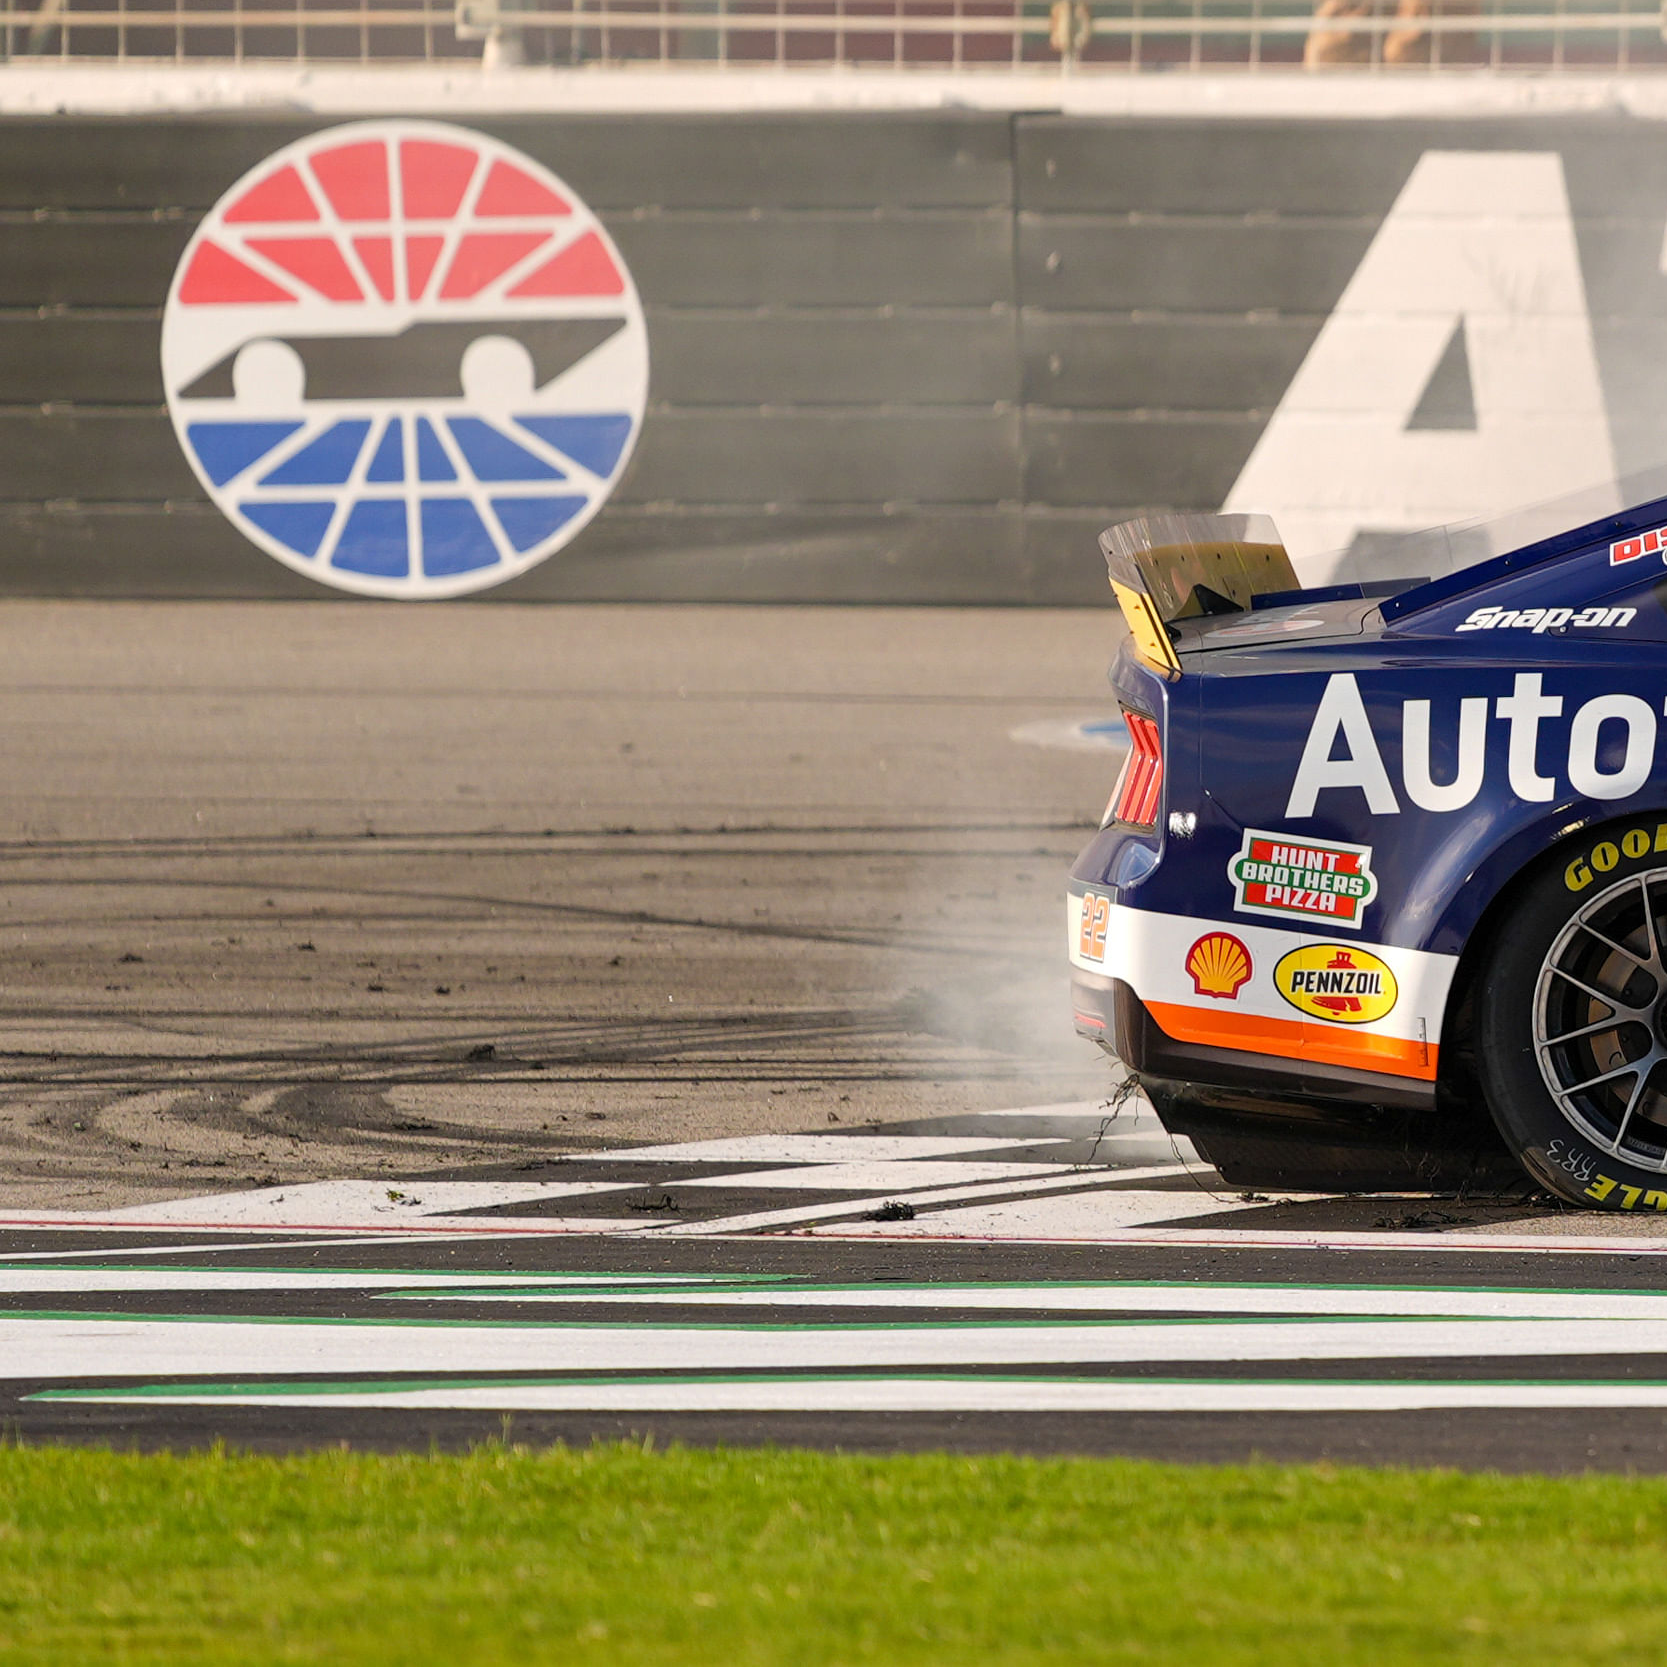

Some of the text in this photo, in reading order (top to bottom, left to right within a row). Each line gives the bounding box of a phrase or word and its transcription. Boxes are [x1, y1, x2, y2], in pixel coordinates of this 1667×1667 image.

[1455, 605, 1638, 634] Snap-on
[1271, 845, 1341, 871] HUNT
[1242, 861, 1364, 896] BROTHERS
[1264, 883, 1337, 912] PIZZA
[1079, 891, 1111, 964] 22
[1291, 970, 1382, 995] PENNZOIL
